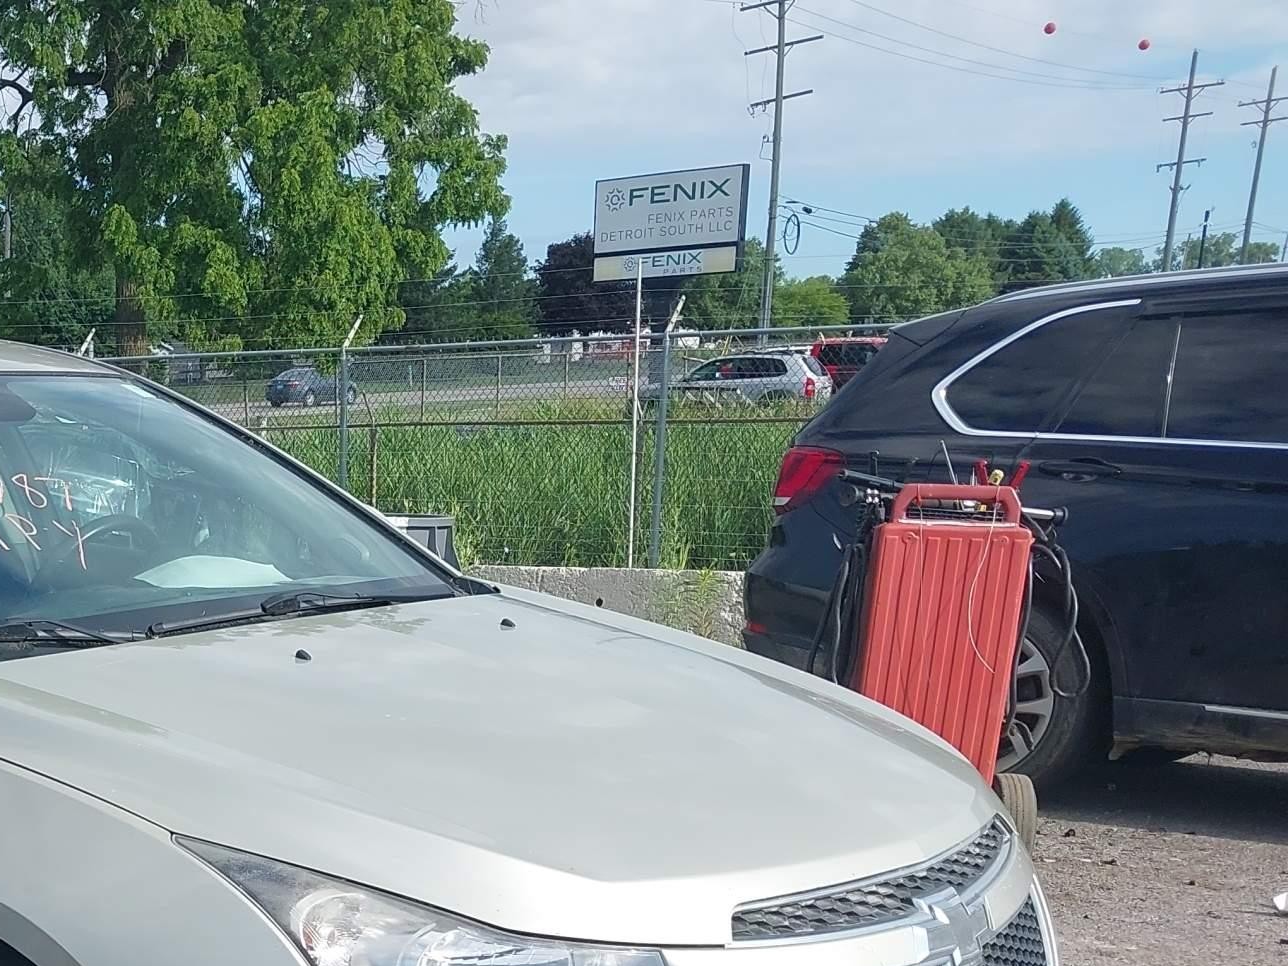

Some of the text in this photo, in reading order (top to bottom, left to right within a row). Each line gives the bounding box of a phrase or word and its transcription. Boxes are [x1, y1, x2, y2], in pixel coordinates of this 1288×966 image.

[628, 178, 732, 207] FENIX
[647, 206, 734, 225] FENIX PARTS
[600, 220, 733, 243] DETROIT SOUTH LLC
[663, 266, 703, 274] PARTS
